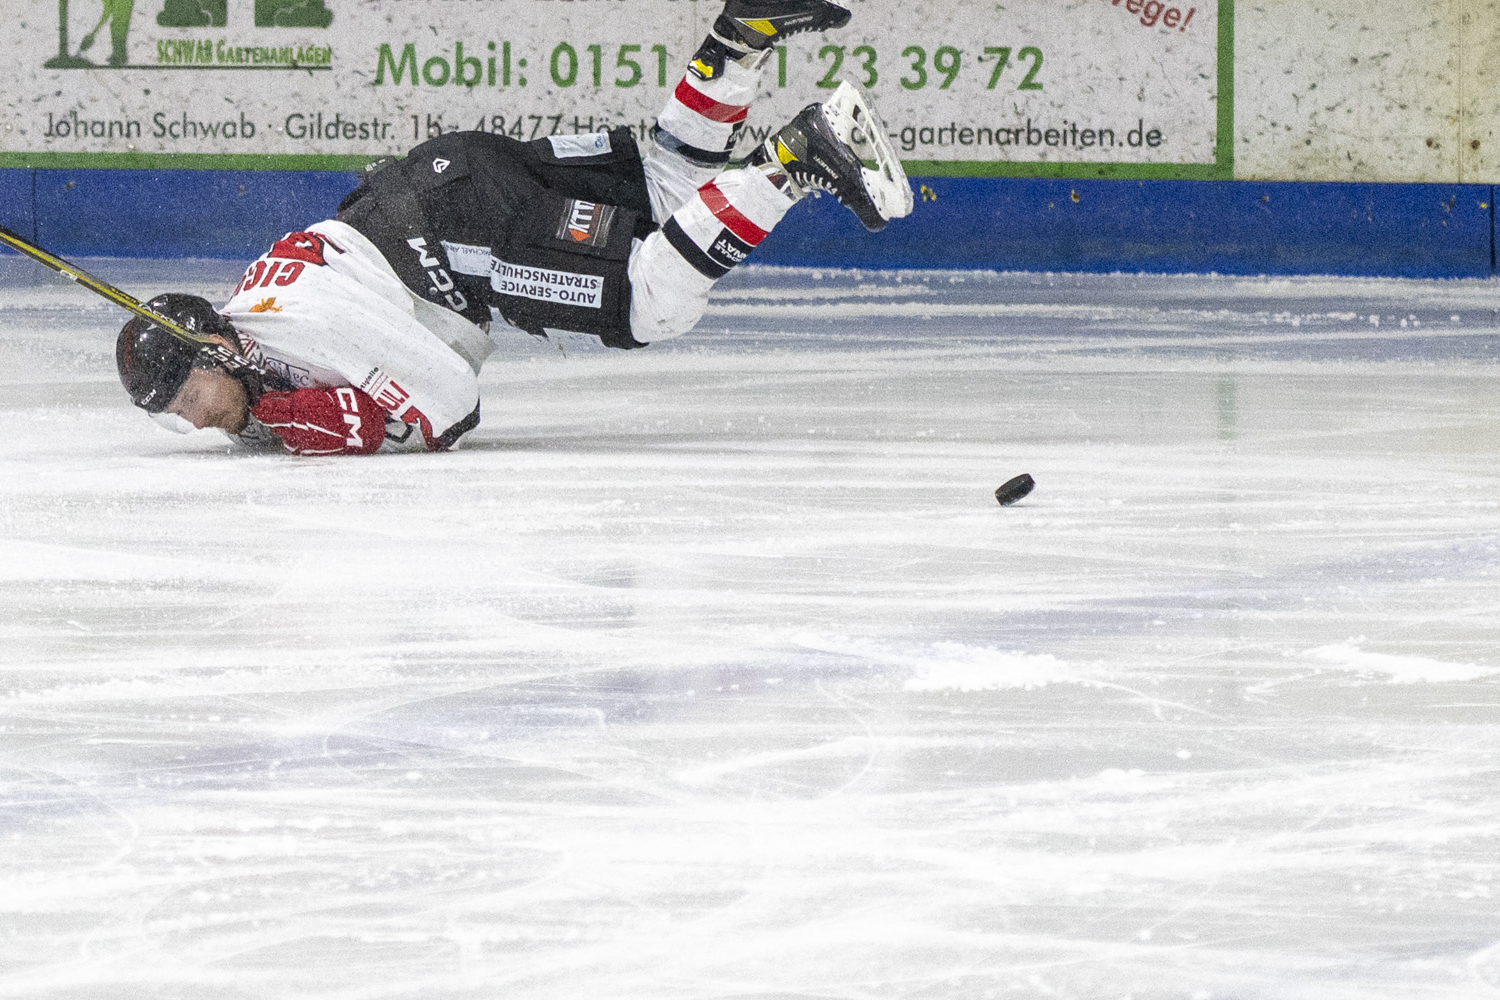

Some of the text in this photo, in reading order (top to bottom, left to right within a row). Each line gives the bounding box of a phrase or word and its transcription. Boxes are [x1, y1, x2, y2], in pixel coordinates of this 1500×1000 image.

[157, 39, 213, 64] SCHWAB
[373, 43, 527, 88] Mobil:
[550, 42, 667, 88] 0151
[816, 45, 878, 89] 23
[901, 46, 961, 90] 39
[978, 47, 1043, 90] 72
[43, 112, 141, 139] Johann
[153, 113, 256, 140] Schwab
[284, 113, 395, 141] Gildestr.
[406, 237, 468, 312] CCM
[490, 258, 599, 290] STRATENSCHULTE
[500, 280, 597, 304] AUTO-SERVICE
